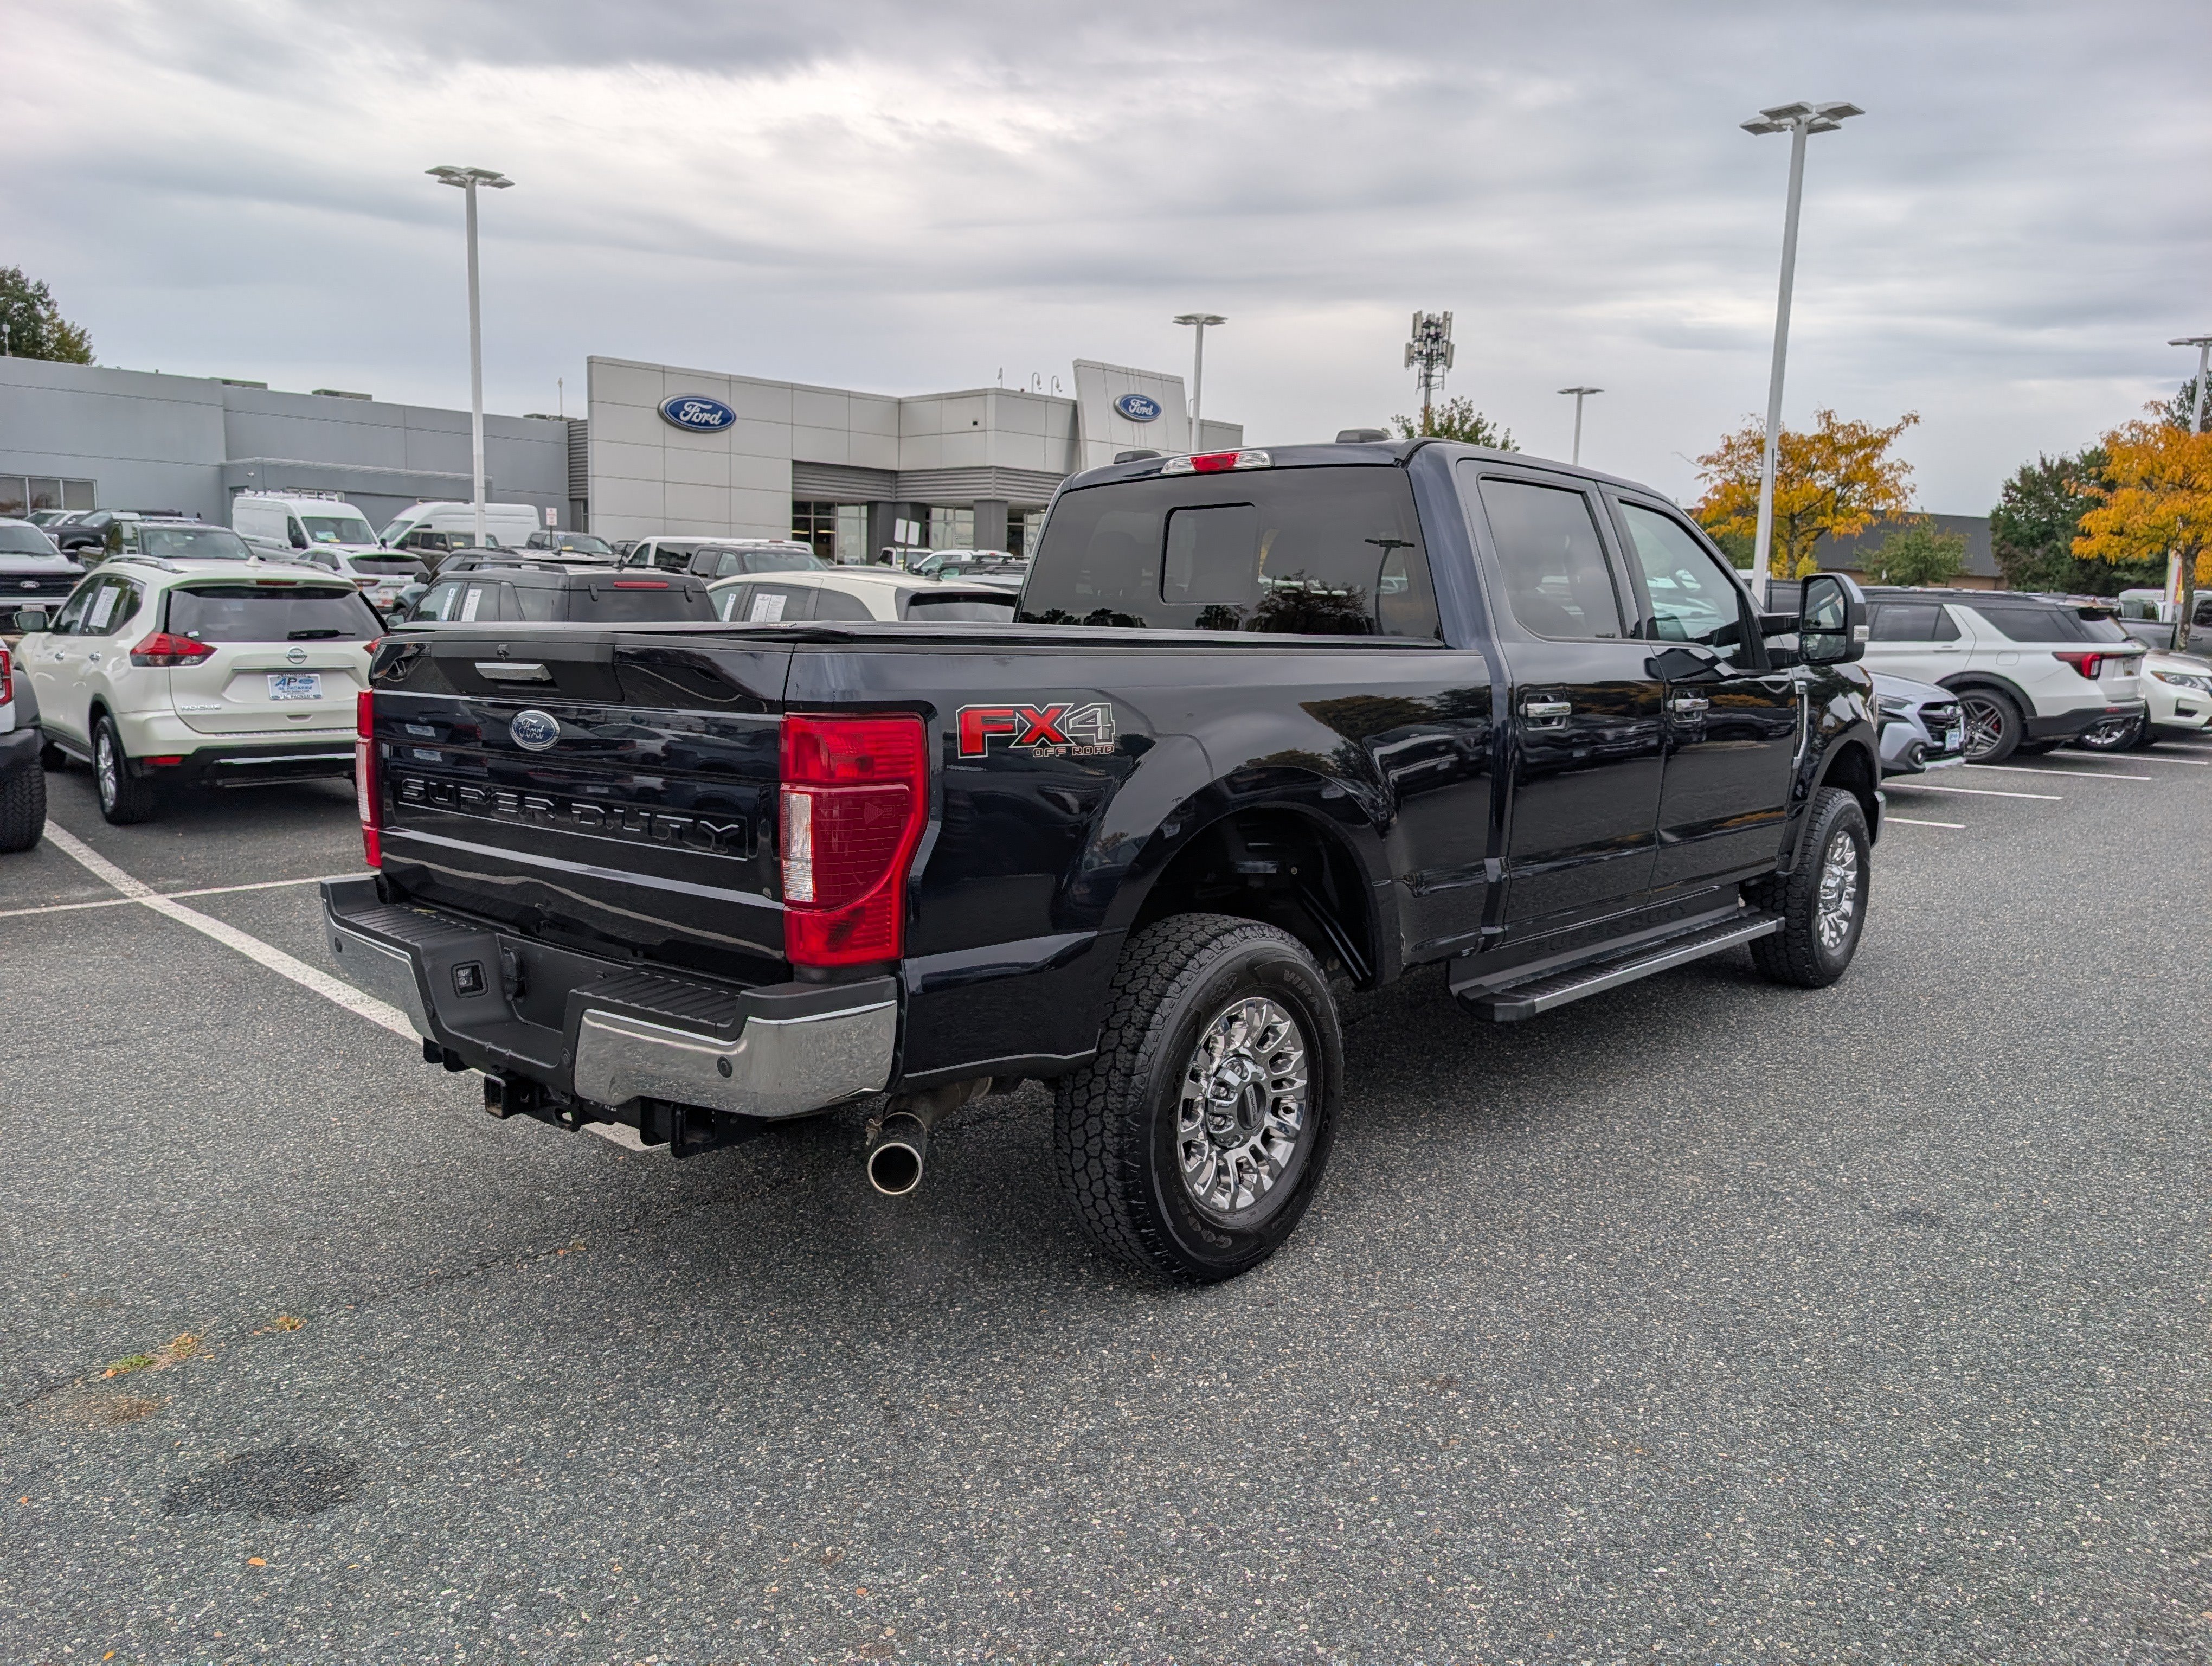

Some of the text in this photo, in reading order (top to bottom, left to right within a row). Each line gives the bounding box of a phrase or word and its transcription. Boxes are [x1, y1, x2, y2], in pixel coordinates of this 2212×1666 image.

[679, 401, 723, 425] Ford
[1128, 398, 1154, 415] Ford
[275, 677, 298, 687] AP
[519, 717, 545, 739] Ford
[955, 703, 1116, 759] FX4
[1032, 745, 1115, 758] OFF ROAD
[402, 778, 740, 853] SUPER DUTY
[1249, 1090, 1257, 1122] FORD
